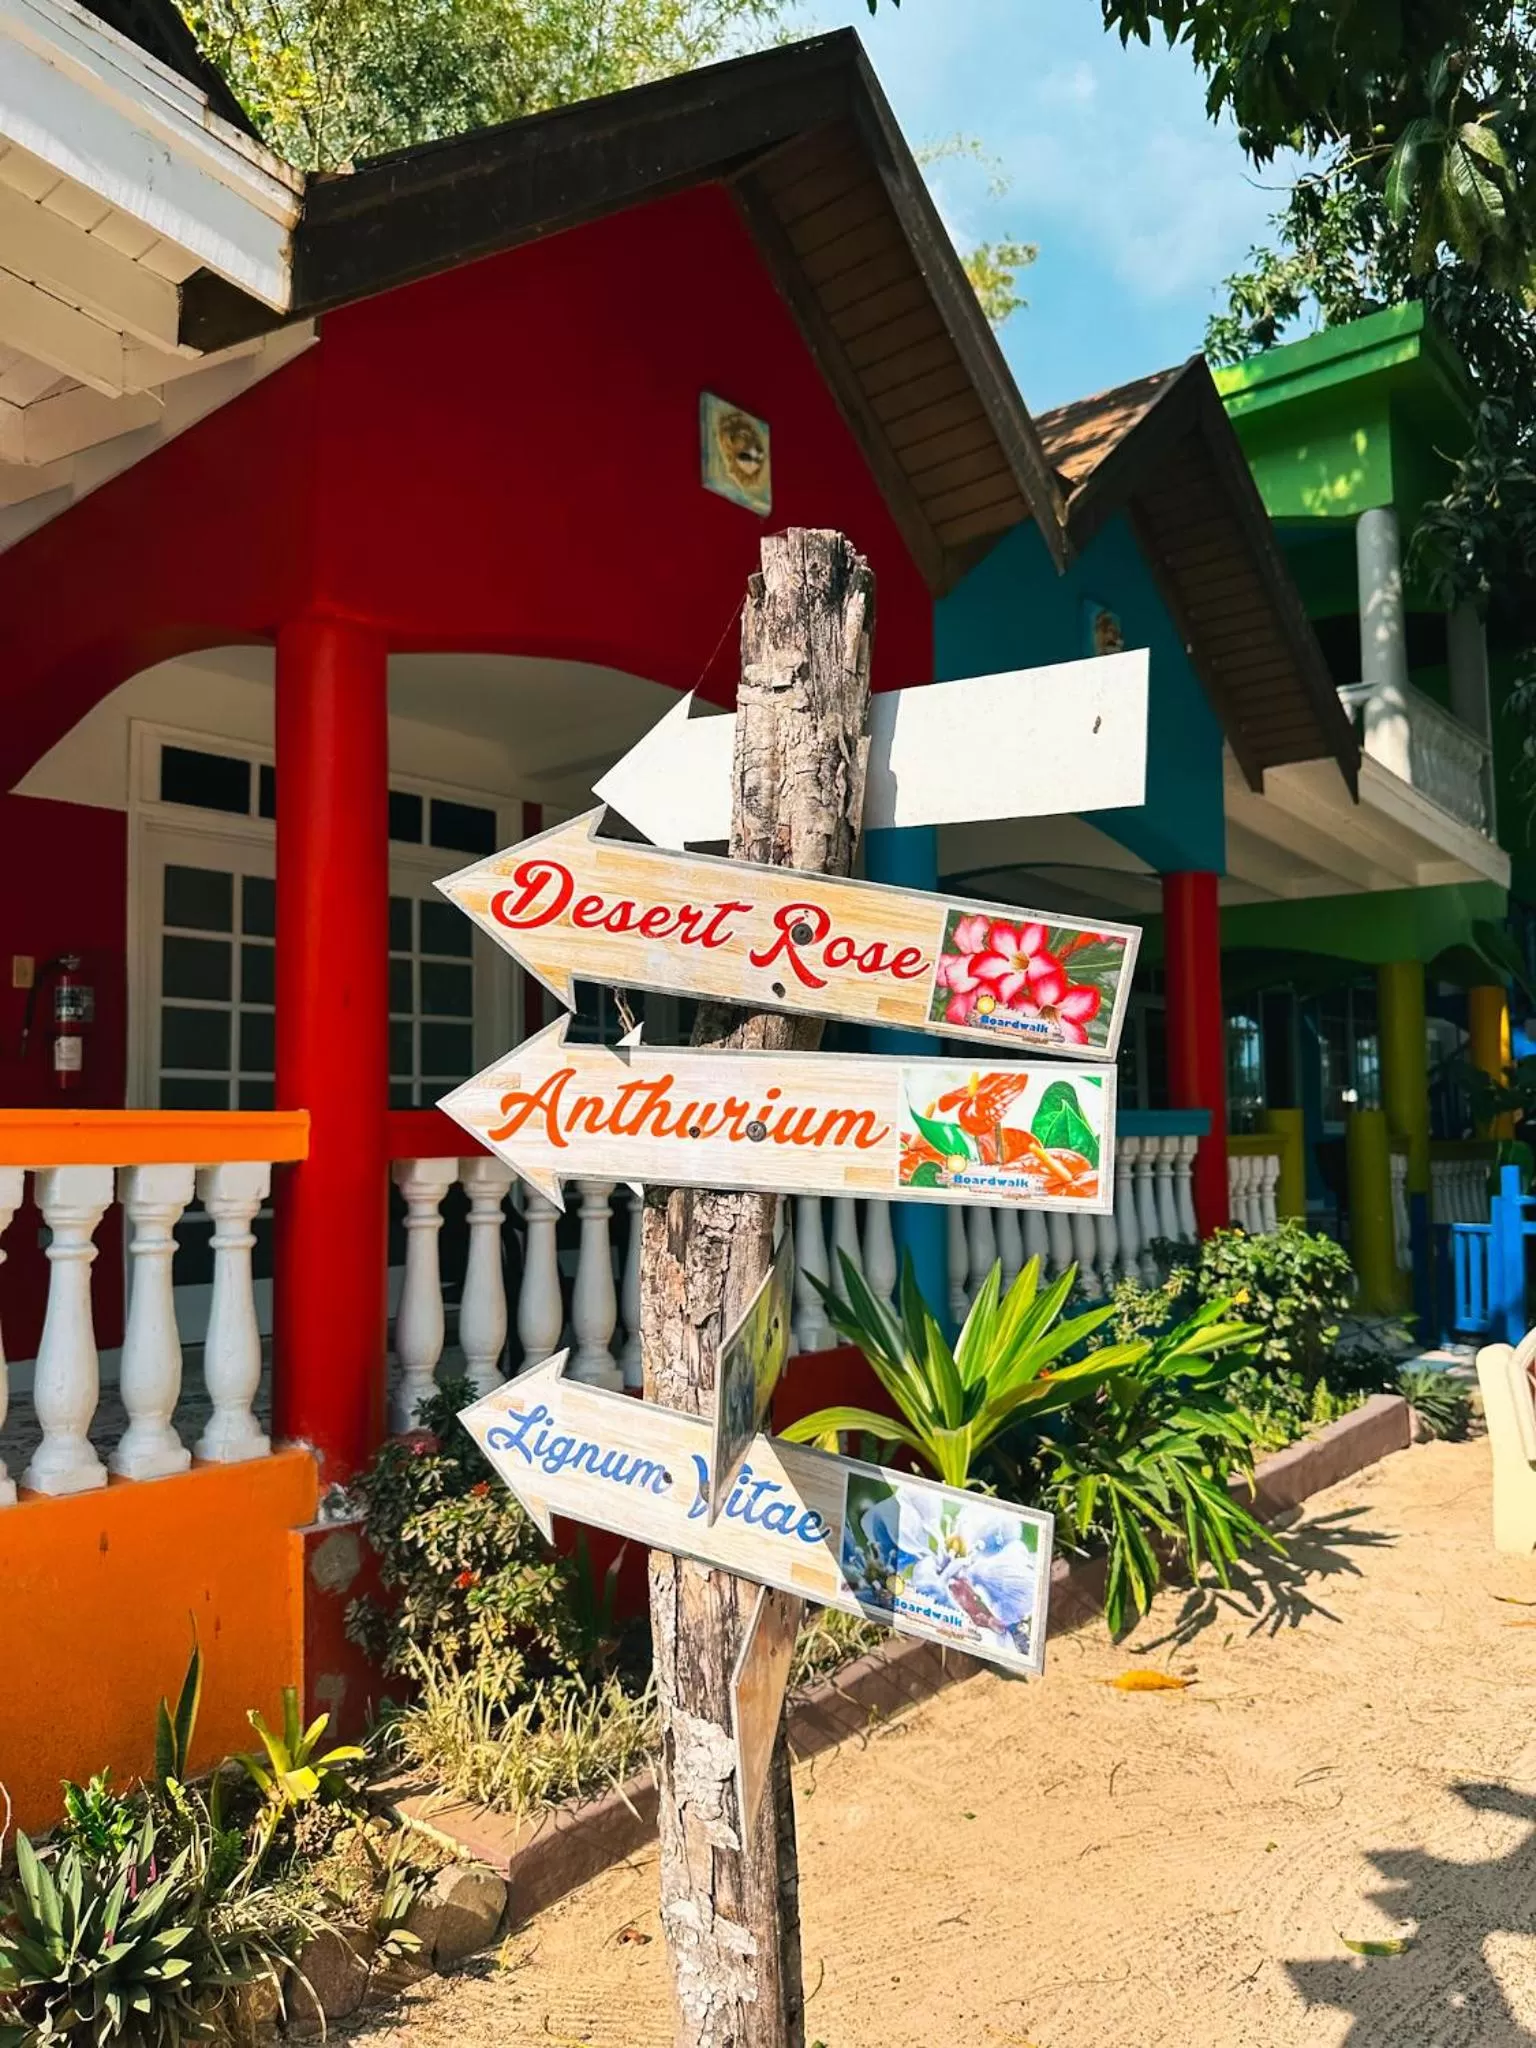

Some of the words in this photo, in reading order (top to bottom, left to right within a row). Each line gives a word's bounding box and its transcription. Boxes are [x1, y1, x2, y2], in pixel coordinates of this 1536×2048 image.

[490, 859, 753, 947] Desert
[750, 903, 929, 989] Rose
[980, 1014, 1049, 1033] Boardwalk
[488, 1067, 889, 1149] Anthurium
[953, 1173, 1029, 1188] Boardwalk
[486, 1404, 671, 1494] Lignum
[892, 1597, 963, 1627] Boardwalk
